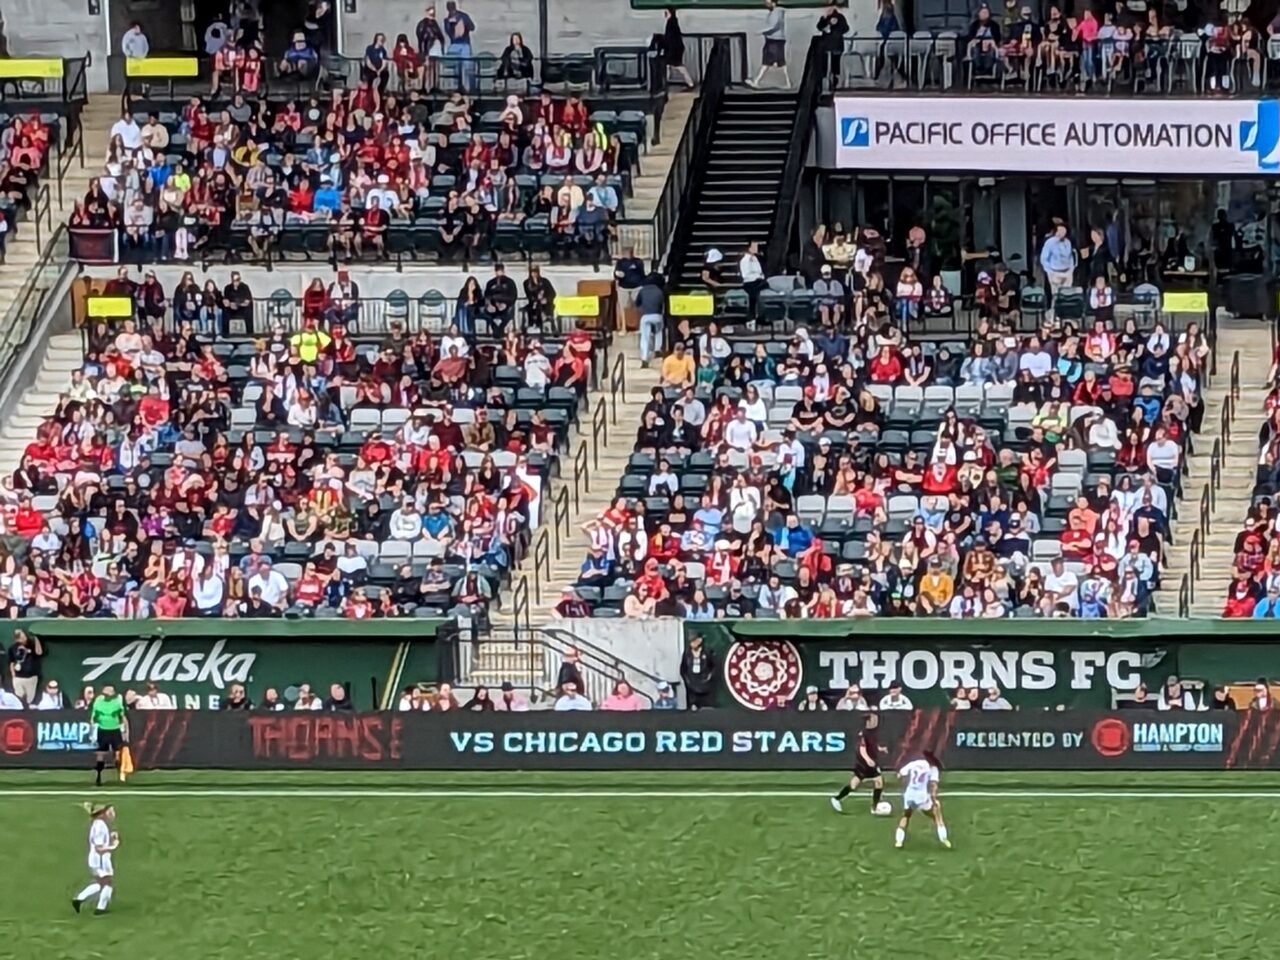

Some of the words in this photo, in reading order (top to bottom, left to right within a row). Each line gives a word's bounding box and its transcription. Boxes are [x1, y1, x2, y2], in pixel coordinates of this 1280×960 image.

[875, 121, 962, 146] PACIFIC
[971, 121, 1056, 147] OFFICE
[1064, 121, 1233, 148] AUTOMATION
[82, 638, 256, 689] Alaska
[819, 650, 1057, 689] THORNS
[1071, 651, 1142, 690] FC
[450, 732, 494, 752] VS
[503, 731, 646, 753] CHICAGO
[655, 731, 723, 753] RED
[732, 731, 846, 753] STARS
[956, 731, 1055, 748] PRESENTED
[1133, 722, 1223, 743] HAMPTON
